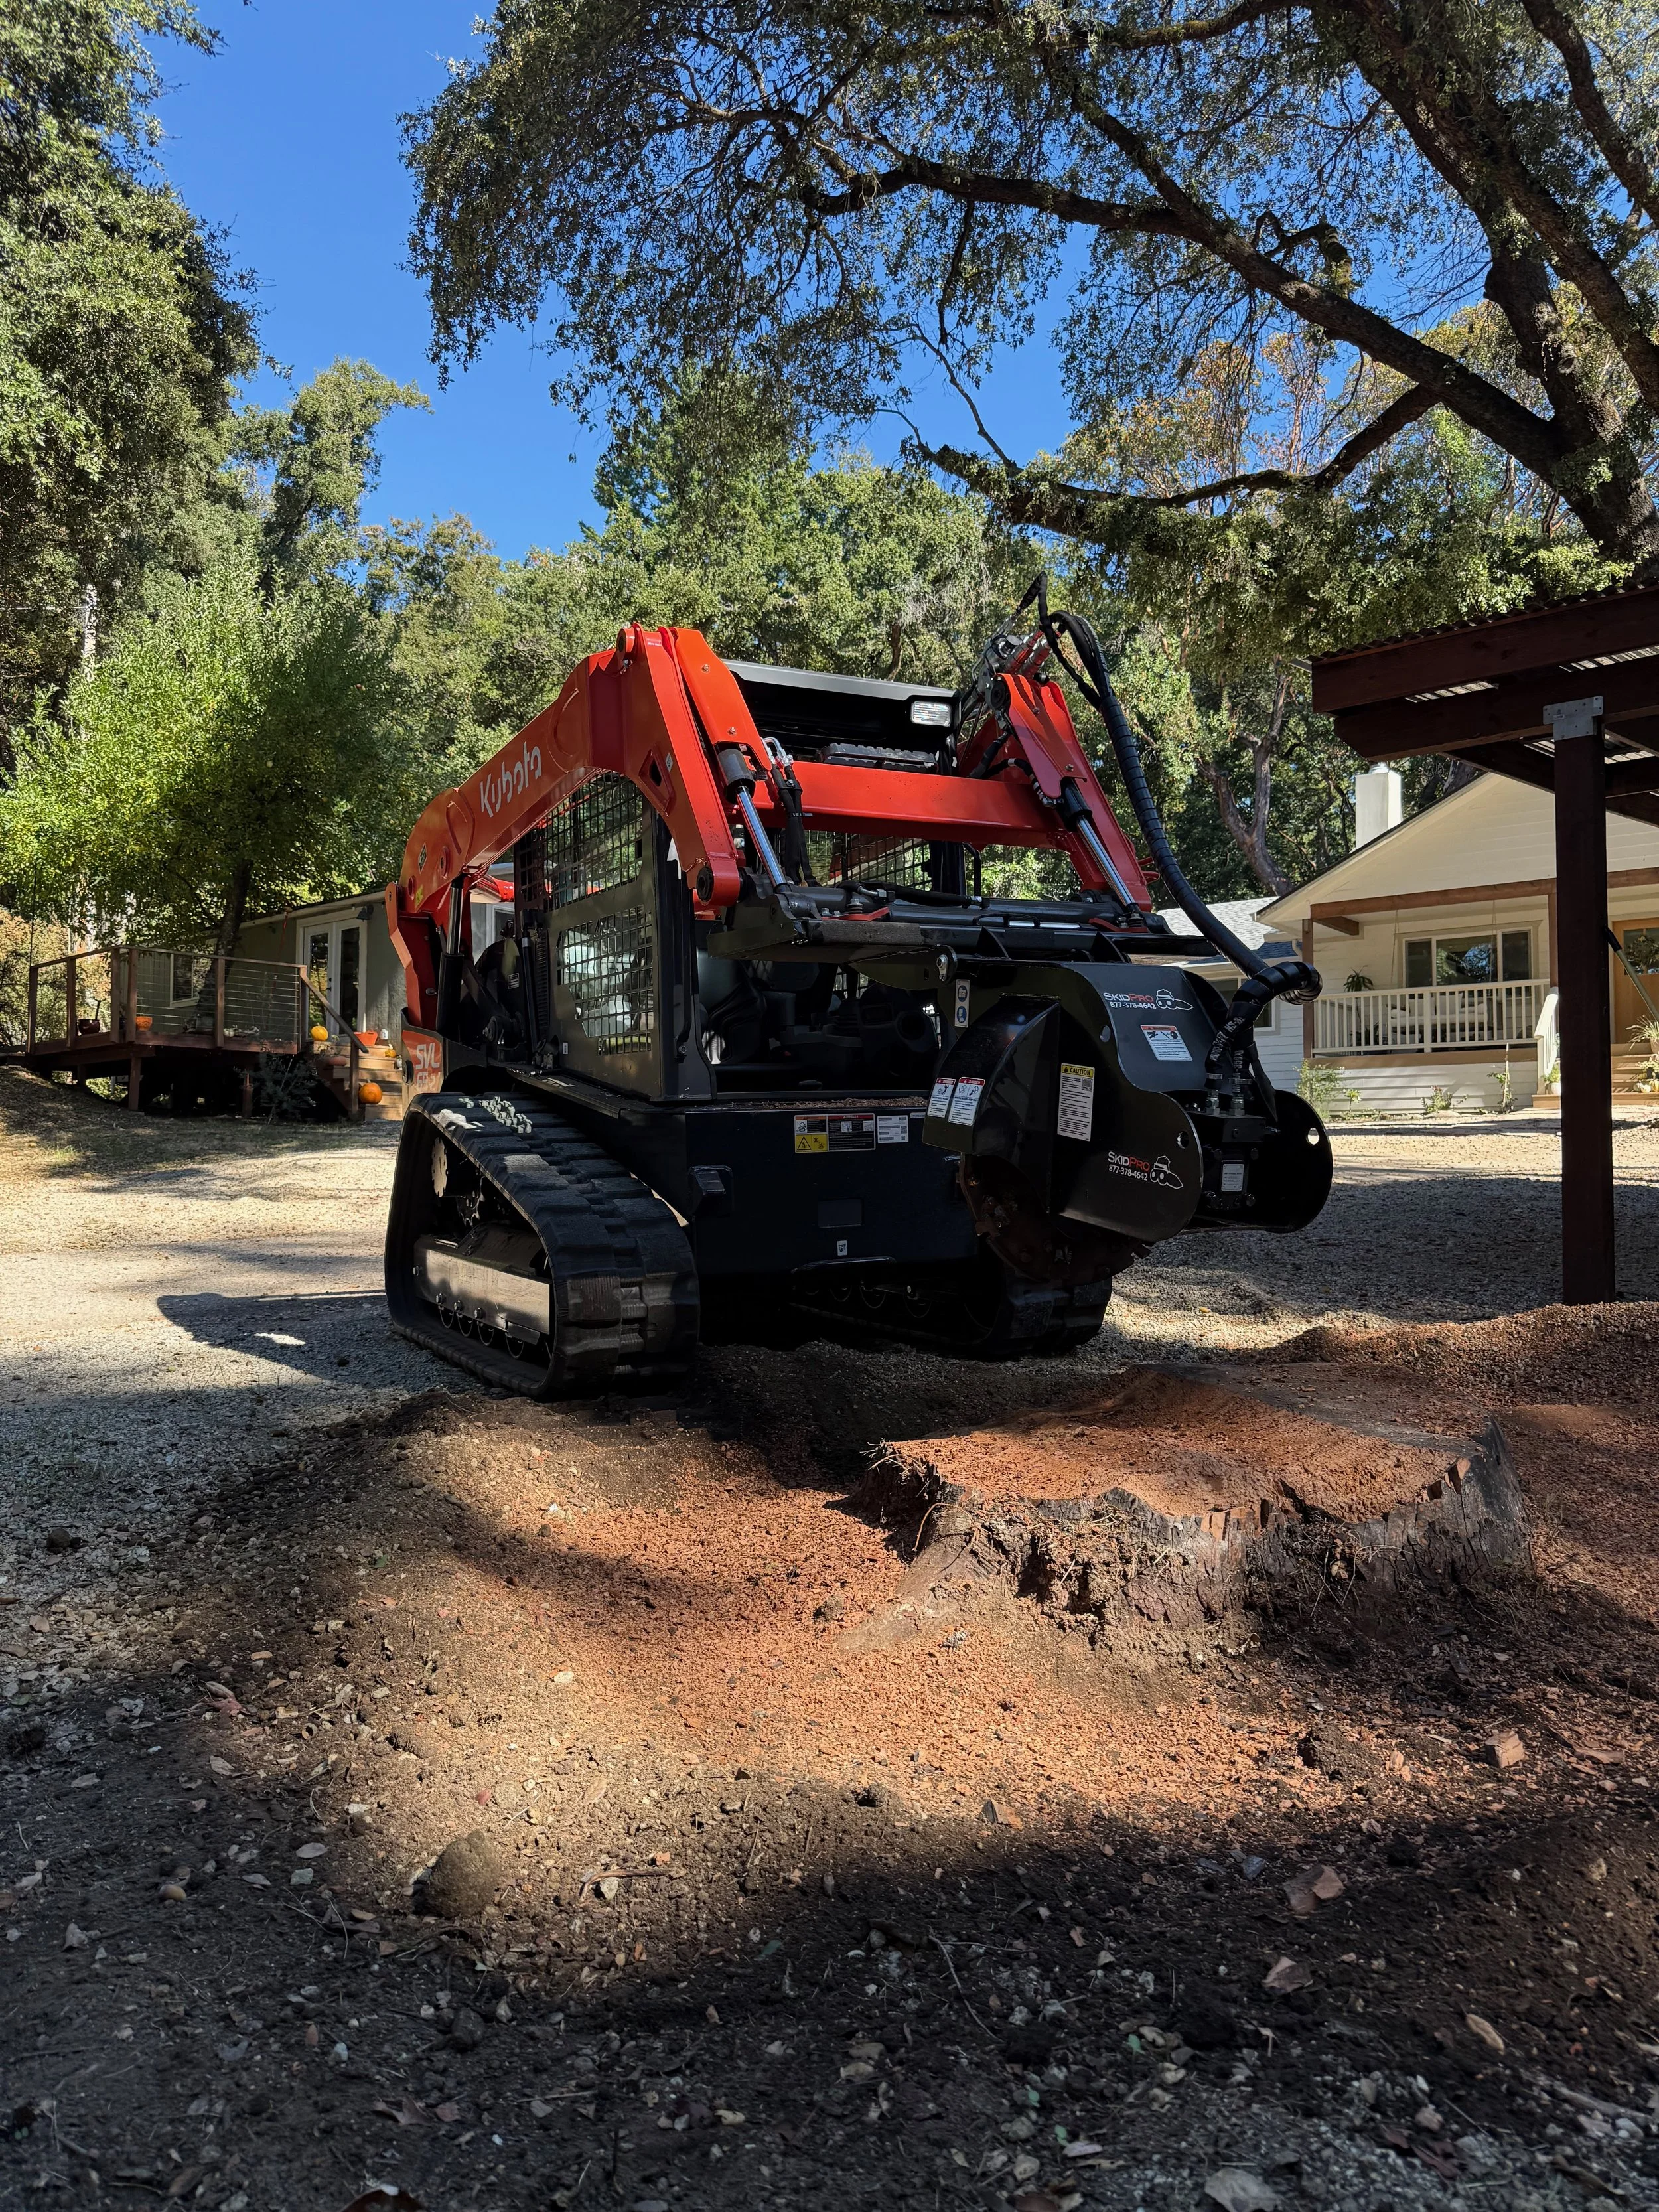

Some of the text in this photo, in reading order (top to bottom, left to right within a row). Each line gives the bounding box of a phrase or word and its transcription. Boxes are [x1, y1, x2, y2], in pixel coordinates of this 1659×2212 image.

[480, 741, 541, 818] Kubota
[415, 1043, 439, 1070] SVL
[1070, 1067, 1090, 1076] CAUTION
[1109, 1164, 1148, 1181] 877-378-4642
